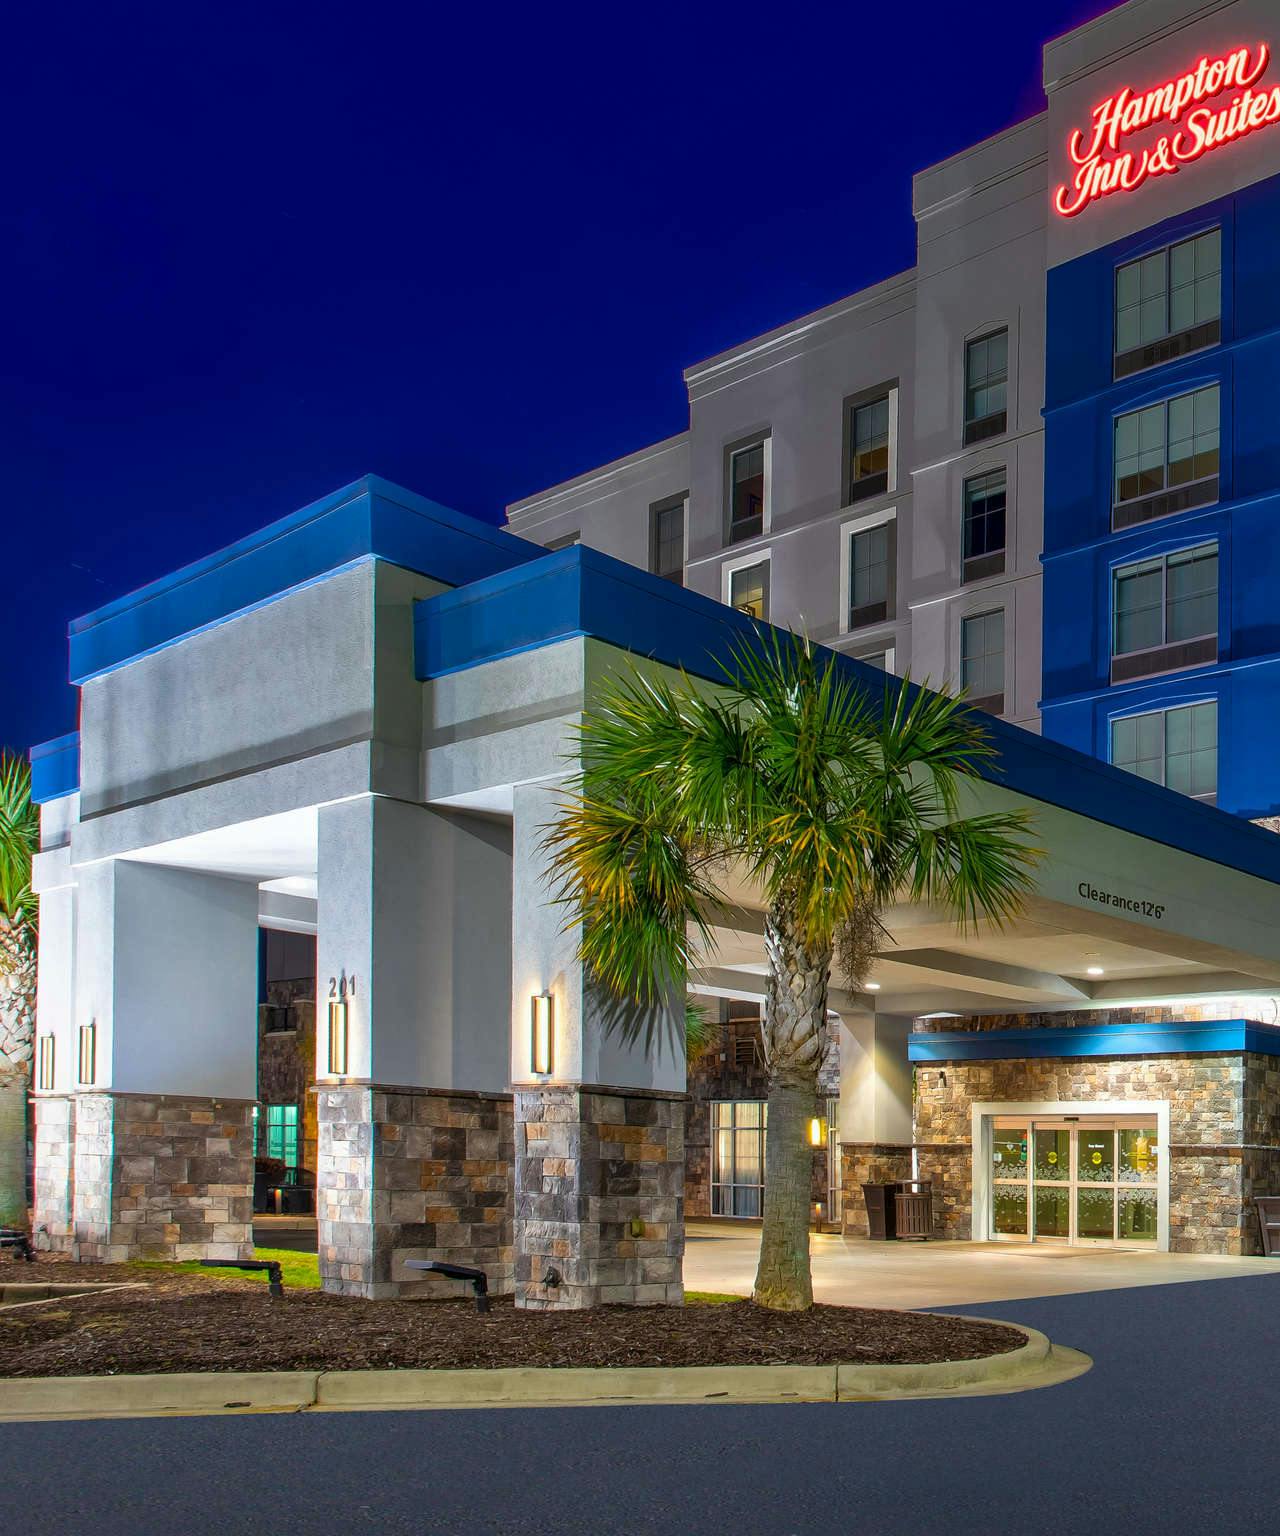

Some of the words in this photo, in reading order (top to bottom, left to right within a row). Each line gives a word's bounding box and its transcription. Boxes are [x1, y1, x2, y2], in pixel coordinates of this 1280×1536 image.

[1070, 43, 1270, 164] Hampton
[1056, 151, 1149, 216] Inn
[1148, 137, 1179, 176] &
[1078, 882, 1140, 913] Clearance
[329, 975, 356, 997] 201
